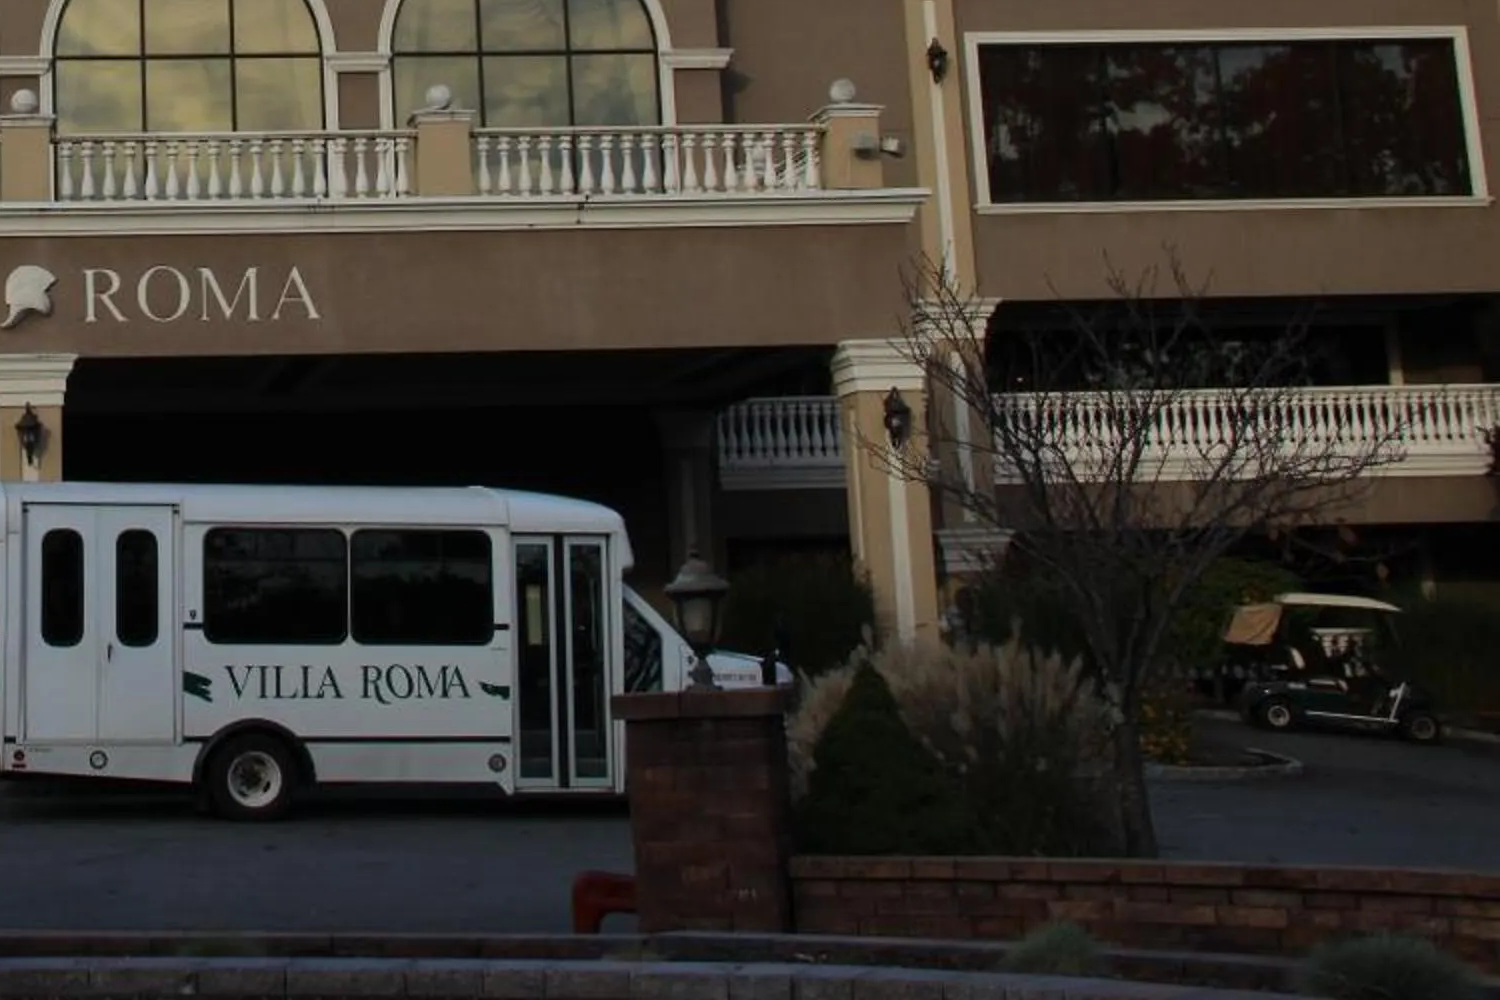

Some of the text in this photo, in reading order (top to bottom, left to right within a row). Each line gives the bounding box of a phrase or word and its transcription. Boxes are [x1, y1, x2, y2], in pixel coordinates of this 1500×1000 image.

[83, 265, 320, 324] ROMA
[224, 663, 471, 705] VILLA ROMA
